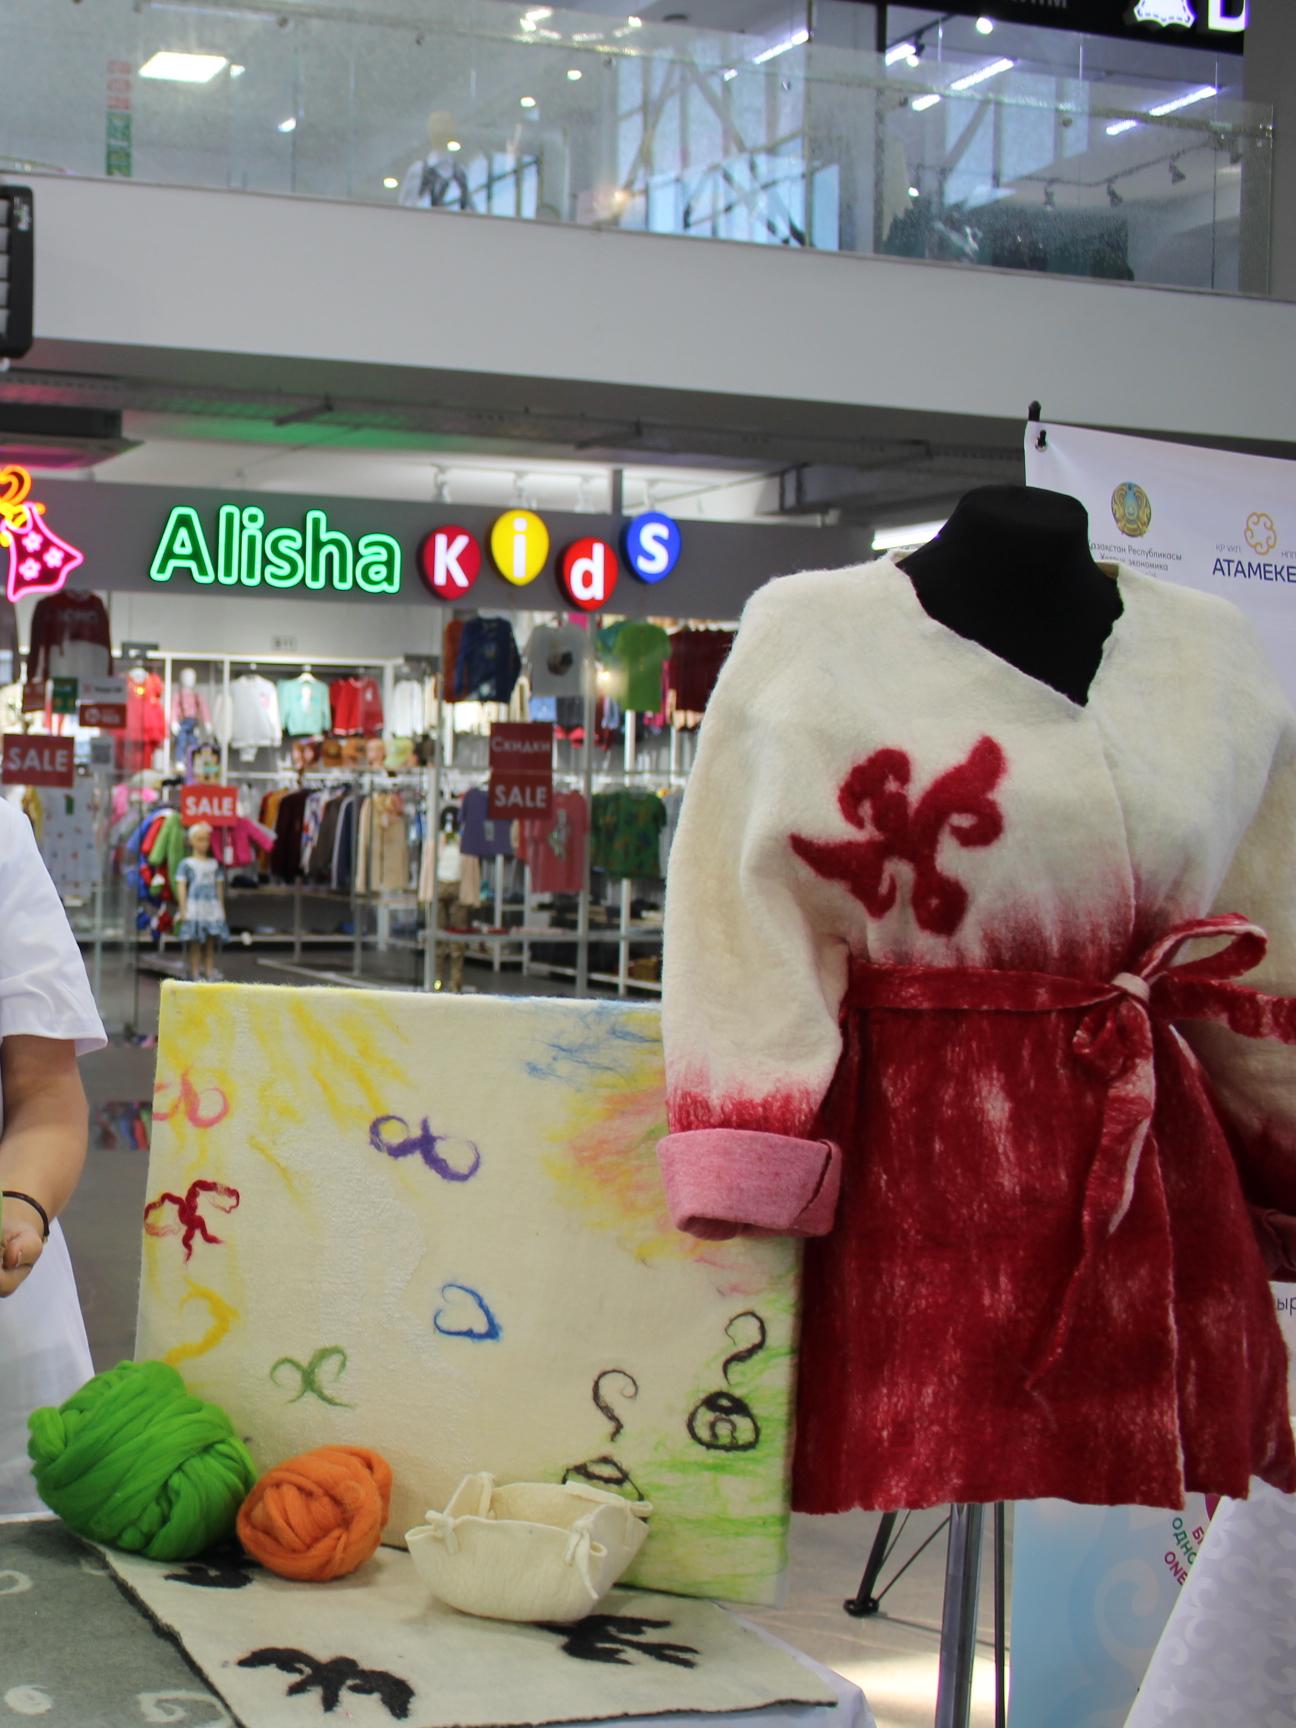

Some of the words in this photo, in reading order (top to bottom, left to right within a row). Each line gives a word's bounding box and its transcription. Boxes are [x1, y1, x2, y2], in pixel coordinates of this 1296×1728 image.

[150, 504, 402, 594] Alisha
[1090, 543, 1126, 555] азақстан
[7, 748, 68, 774] SALE
[185, 793, 234, 817] SALE
[494, 783, 547, 809] SALE
